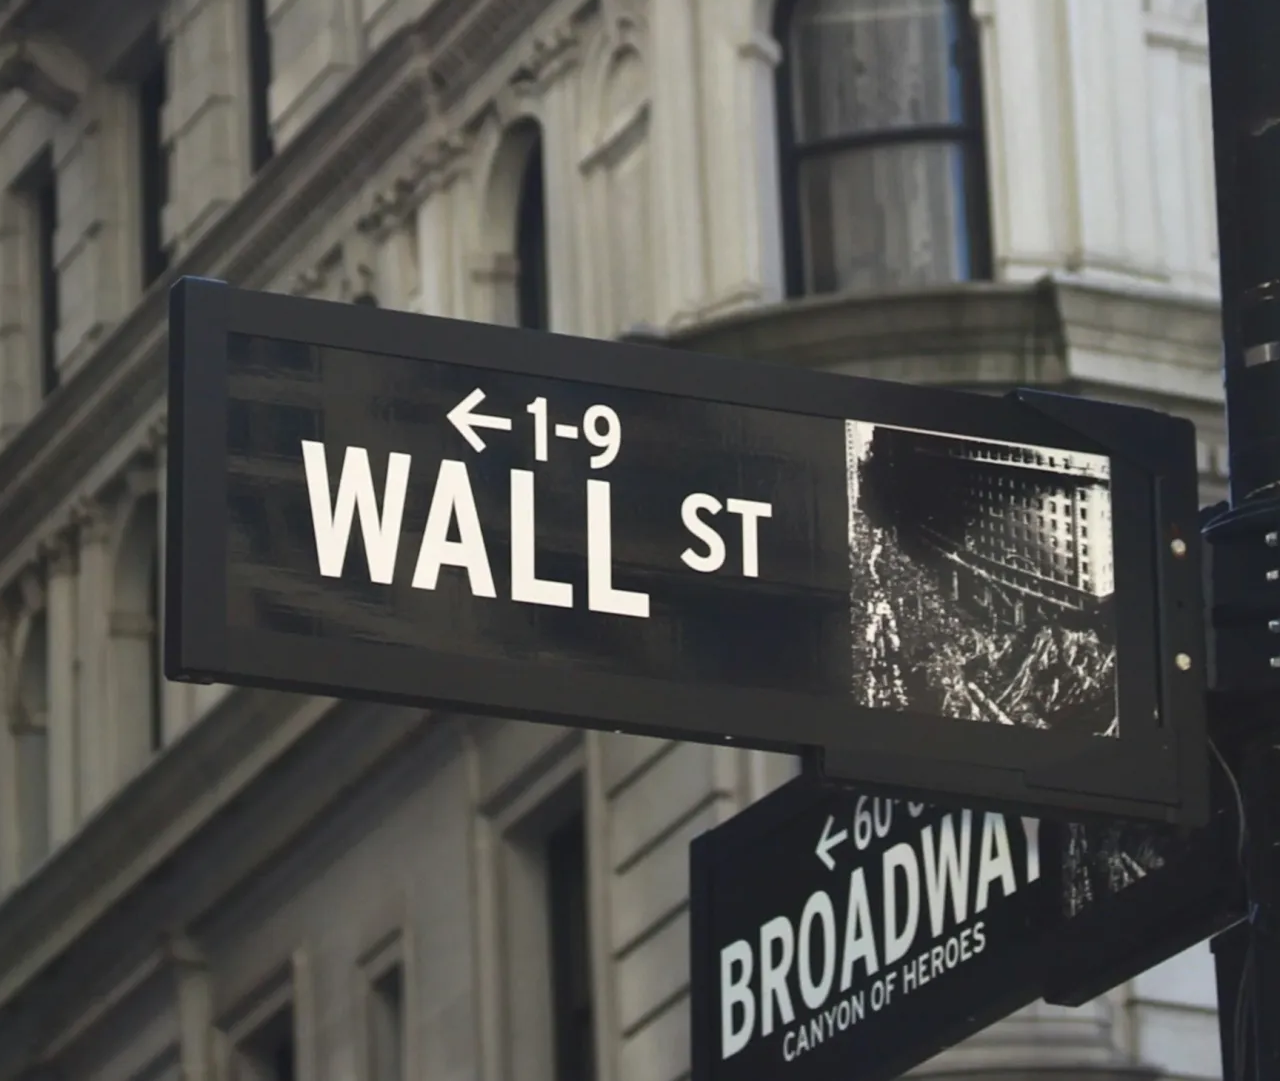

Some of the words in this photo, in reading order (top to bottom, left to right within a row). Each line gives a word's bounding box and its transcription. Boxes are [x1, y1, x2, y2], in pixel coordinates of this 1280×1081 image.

[526, 397, 621, 469] 1-9
[301, 440, 650, 617] WALL
[680, 493, 773, 578] ST
[782, 996, 864, 1062] CANYON
[871, 971, 897, 1011] OF
[902, 922, 986, 993] HEROES
